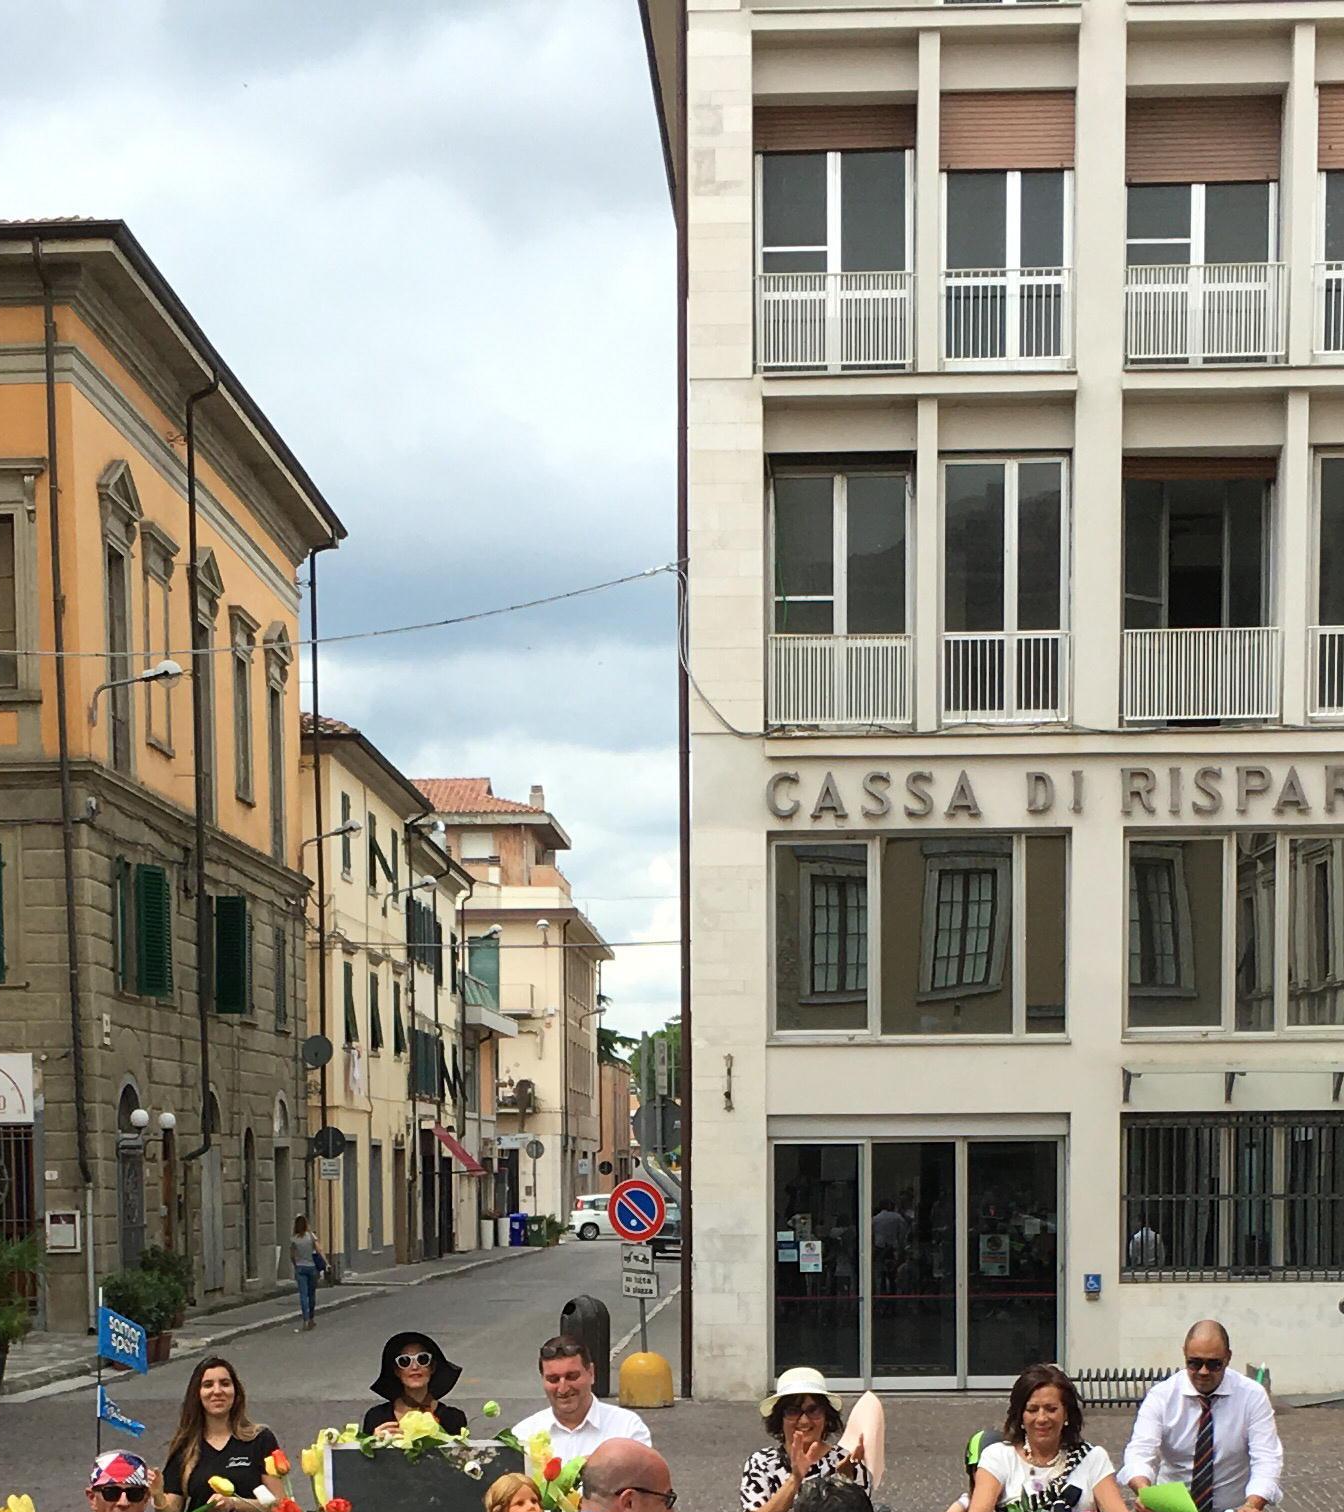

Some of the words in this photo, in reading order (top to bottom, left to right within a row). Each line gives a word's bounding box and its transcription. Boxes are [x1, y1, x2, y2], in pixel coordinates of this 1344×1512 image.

[766, 770, 982, 818] CASSA
[1026, 770, 1083, 814] DI
[111, 1333, 139, 1358] sport
